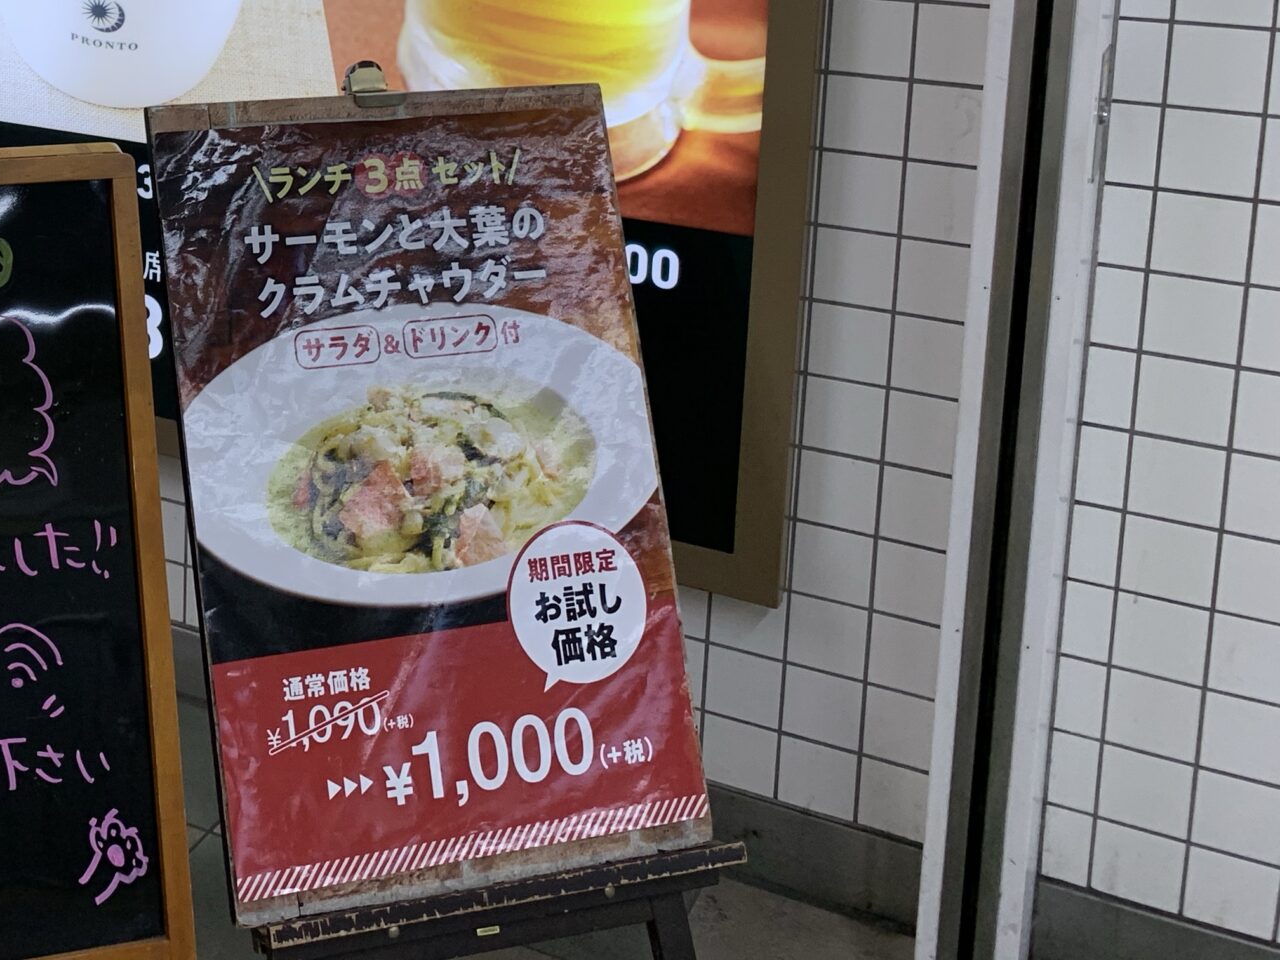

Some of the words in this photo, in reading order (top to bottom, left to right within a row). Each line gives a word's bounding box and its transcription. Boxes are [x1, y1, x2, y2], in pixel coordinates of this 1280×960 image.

[71, 32, 138, 51] PRONTO
[243, 206, 547, 265] サーモンと大葉の
[256, 255, 548, 320] クラムチャウダー
[527, 548, 618, 584] 期間限定
[533, 582, 622, 625] お試し
[551, 623, 619, 667] 価格
[282, 666, 371, 702] 通常価格
